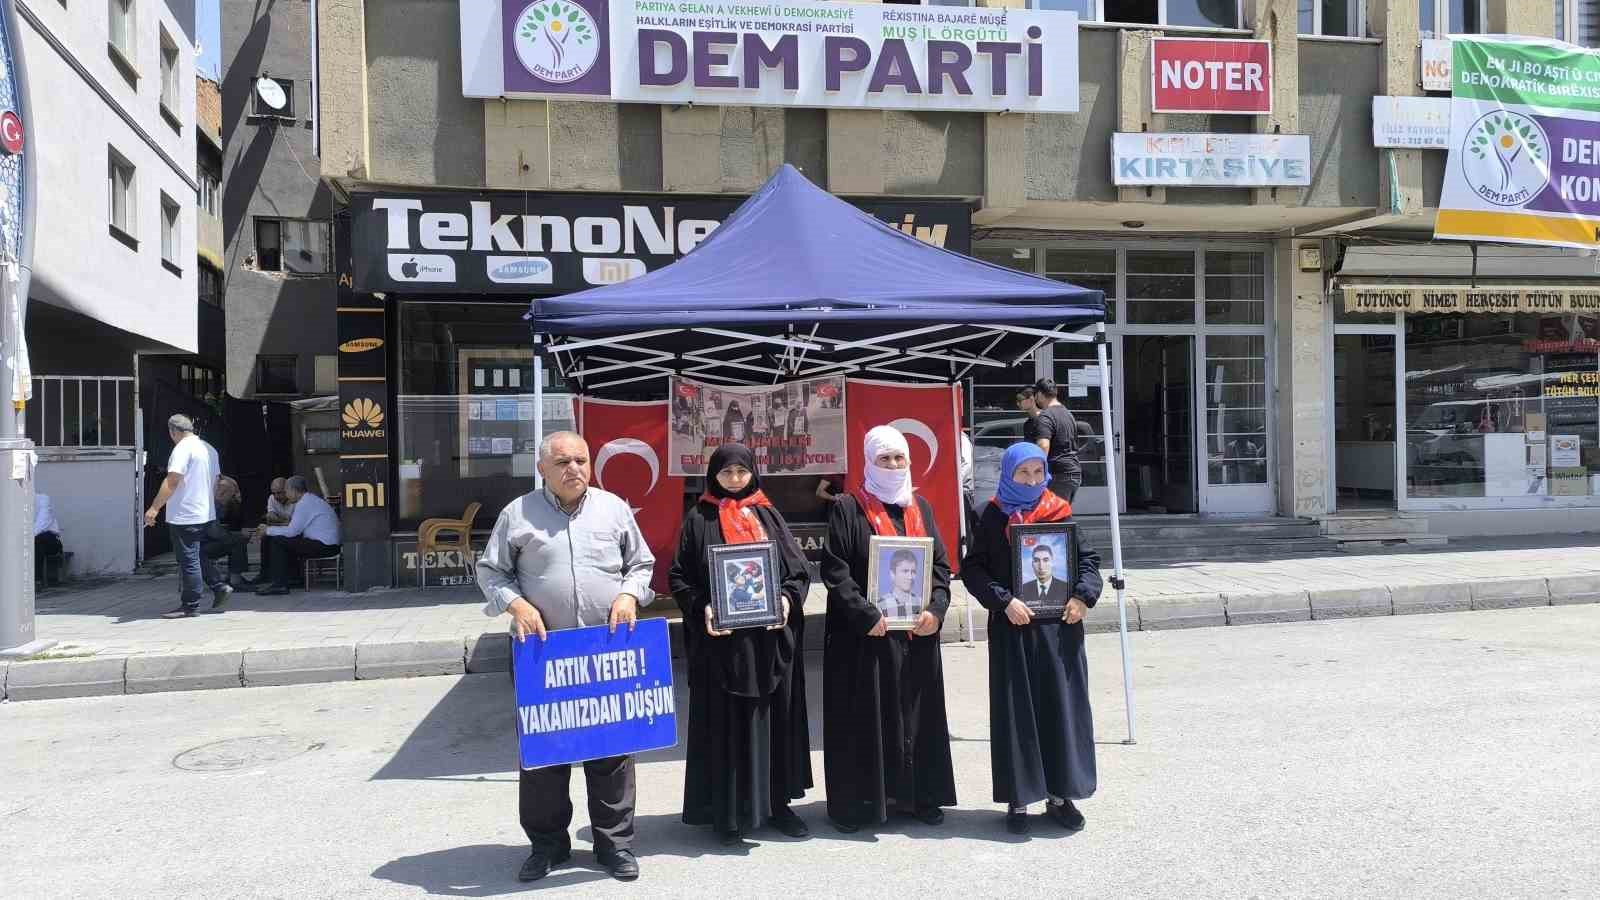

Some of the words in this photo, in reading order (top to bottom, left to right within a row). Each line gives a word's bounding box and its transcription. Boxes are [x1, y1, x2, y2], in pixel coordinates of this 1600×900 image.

[636, 16, 696, 28] HALKLARIN
[698, 17, 737, 31] EŞİTLİK
[739, 21, 753, 31] VE
[754, 20, 812, 34] DEMOKRASİ
[815, 22, 854, 34] PARTİSİ
[883, 26, 917, 41] MUŞ
[922, 27, 936, 39] İL
[941, 26, 1007, 41] ÖRGÜTÜ
[638, 28, 799, 90] DEM
[825, 25, 1043, 97] PARTİ
[1523, 61, 1542, 76] BO
[533, 64, 553, 77] DEM
[555, 63, 582, 79] PARTİ
[1161, 59, 1264, 92] NOTER
[1119, 155, 1305, 178] KIRTASİYE
[1480, 184, 1501, 201] DEM
[1502, 186, 1530, 203] PARTİ
[419, 265, 443, 273] iPhone
[1356, 292, 1412, 307] TÜTÜNCÜ
[1423, 293, 1459, 307] NİMET
[1526, 294, 1562, 308] TÜTÜN
[342, 430, 384, 438] HUAWEI
[545, 655, 591, 689] ARTIK
[592, 649, 637, 681] YETER
[639, 647, 646, 676] !
[519, 694, 622, 735] YAKAMIZDAN
[624, 679, 674, 725] DÜŞÜN
